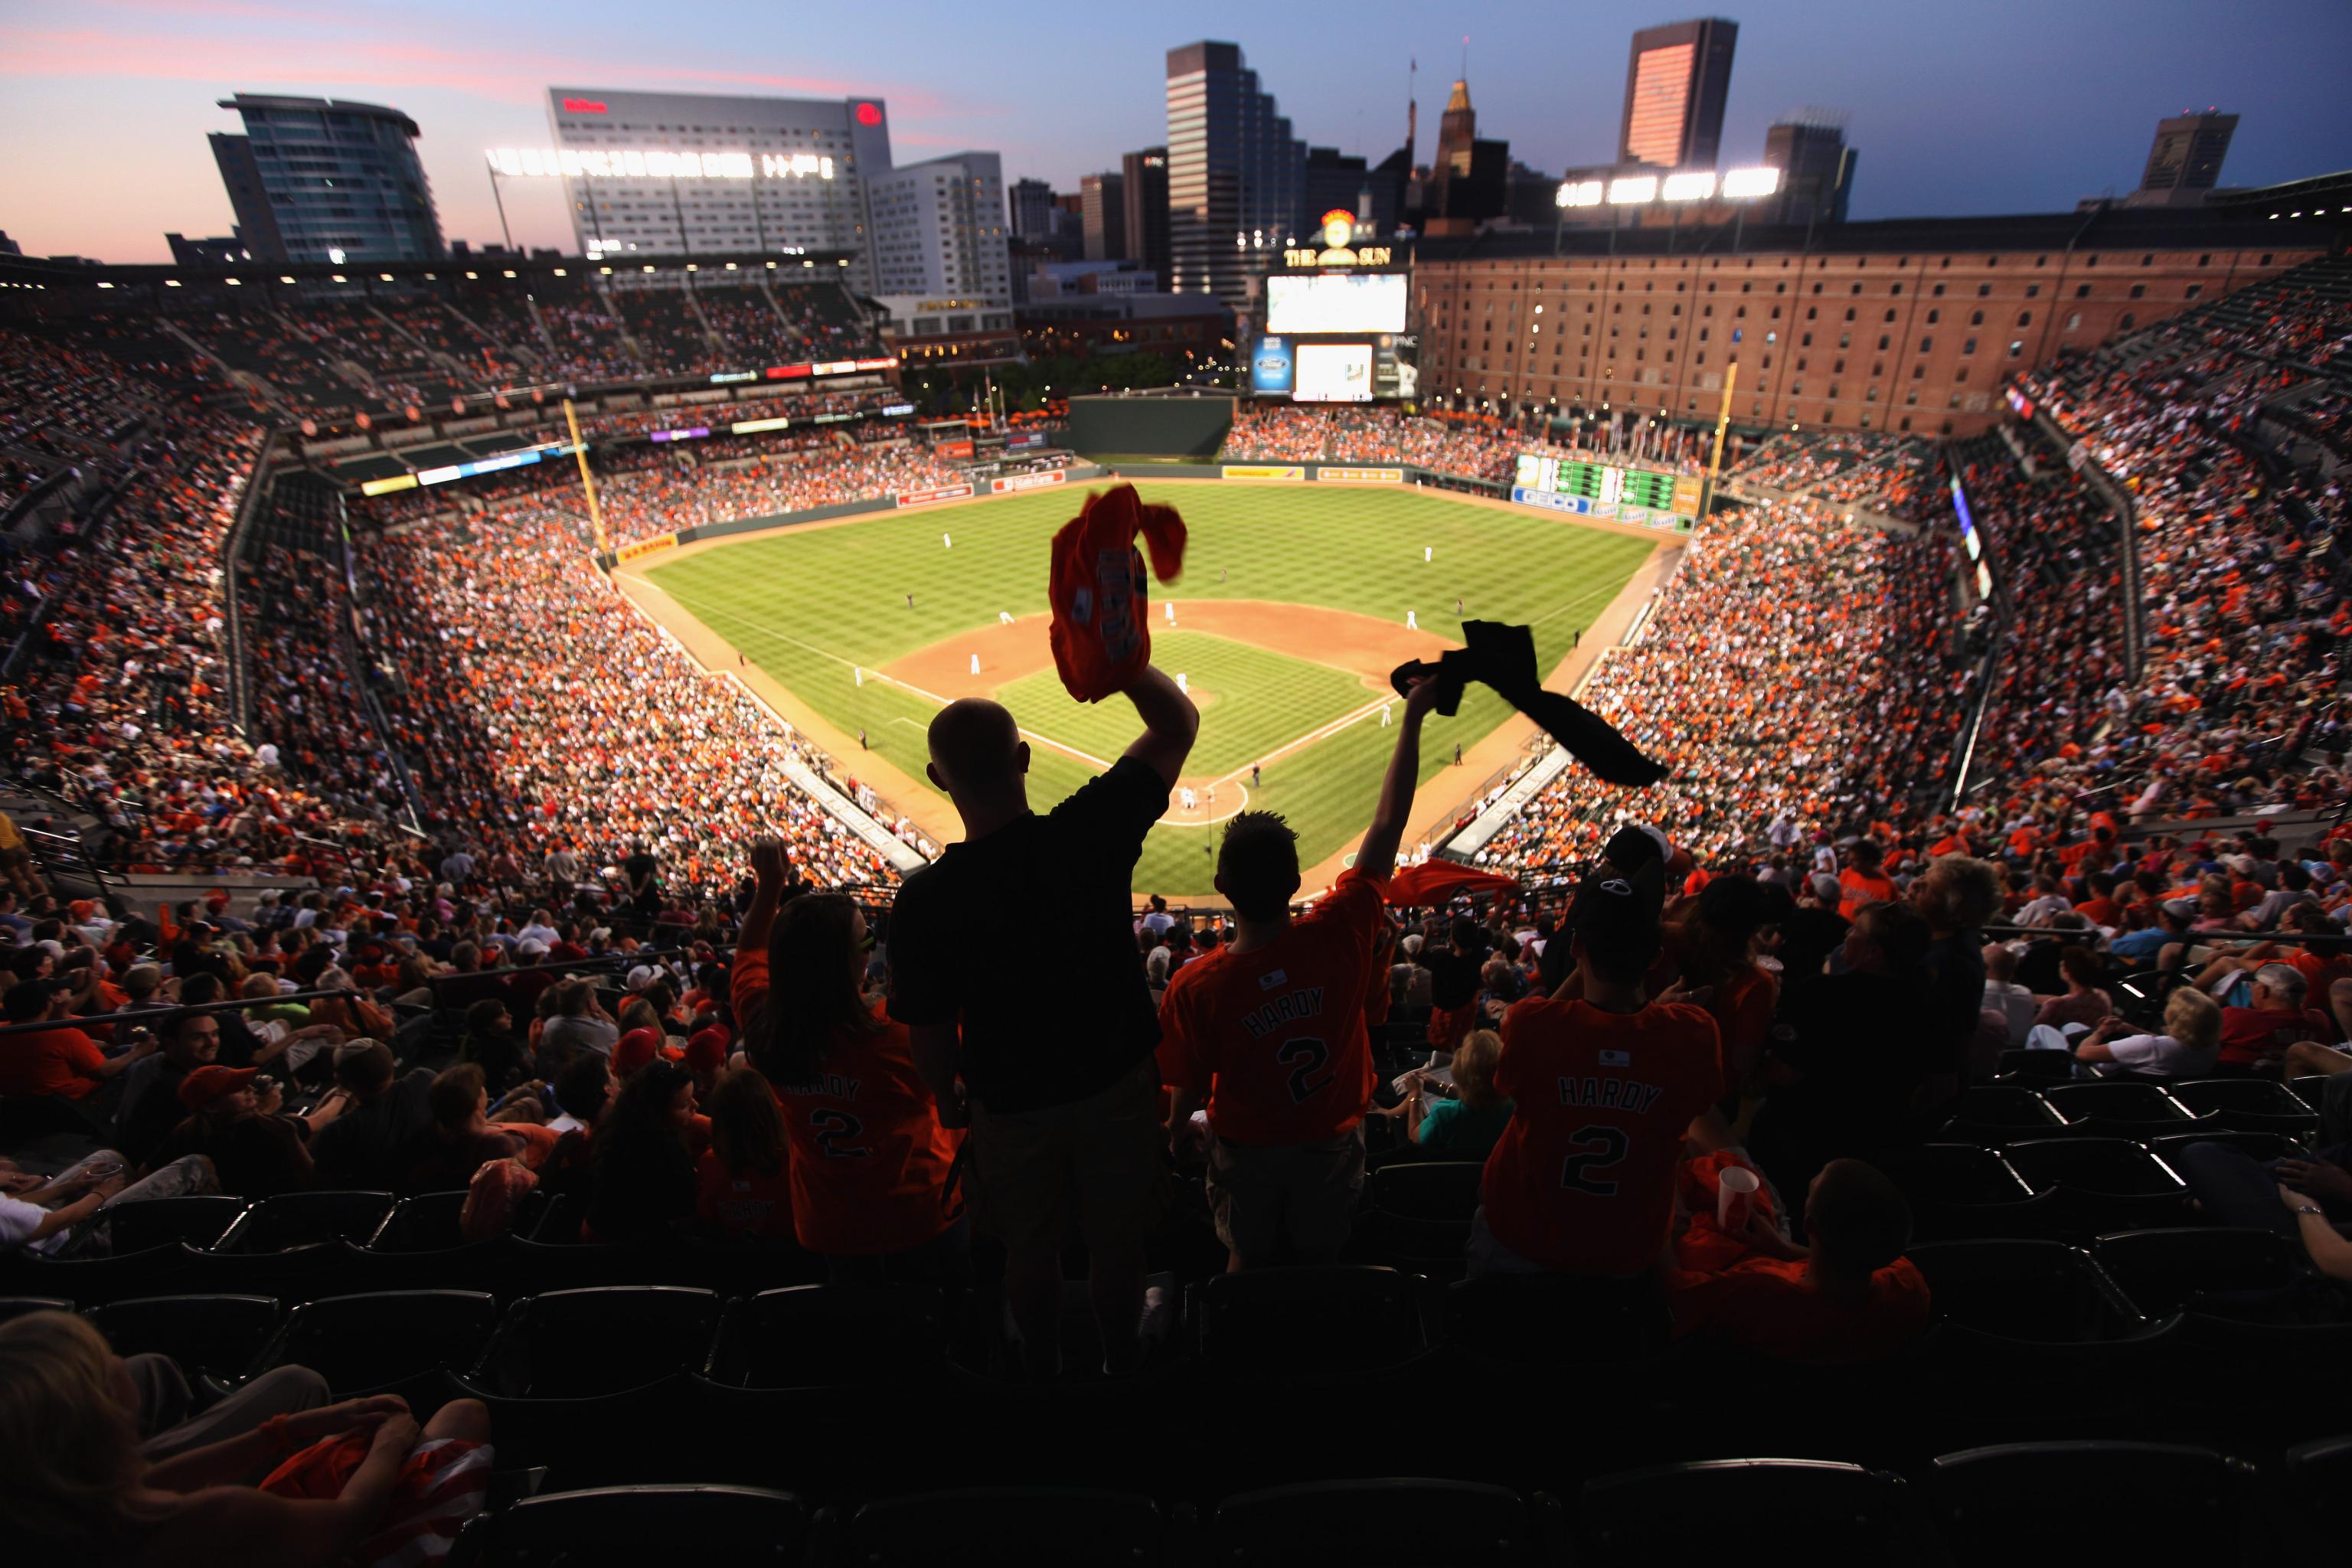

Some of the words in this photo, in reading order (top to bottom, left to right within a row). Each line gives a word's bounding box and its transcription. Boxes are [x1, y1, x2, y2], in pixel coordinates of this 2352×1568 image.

[1284, 249, 1317, 266] THE
[1358, 247, 1391, 266] SUN
[1393, 335, 1419, 348] PNC
[1523, 488, 1579, 512] GEICO
[1243, 987, 1324, 1039] HARDY
[1276, 1037, 1335, 1103] 2
[1558, 1076, 1664, 1115] HARDY
[809, 1108, 871, 1159] 2
[1560, 1124, 1629, 1197] 2
